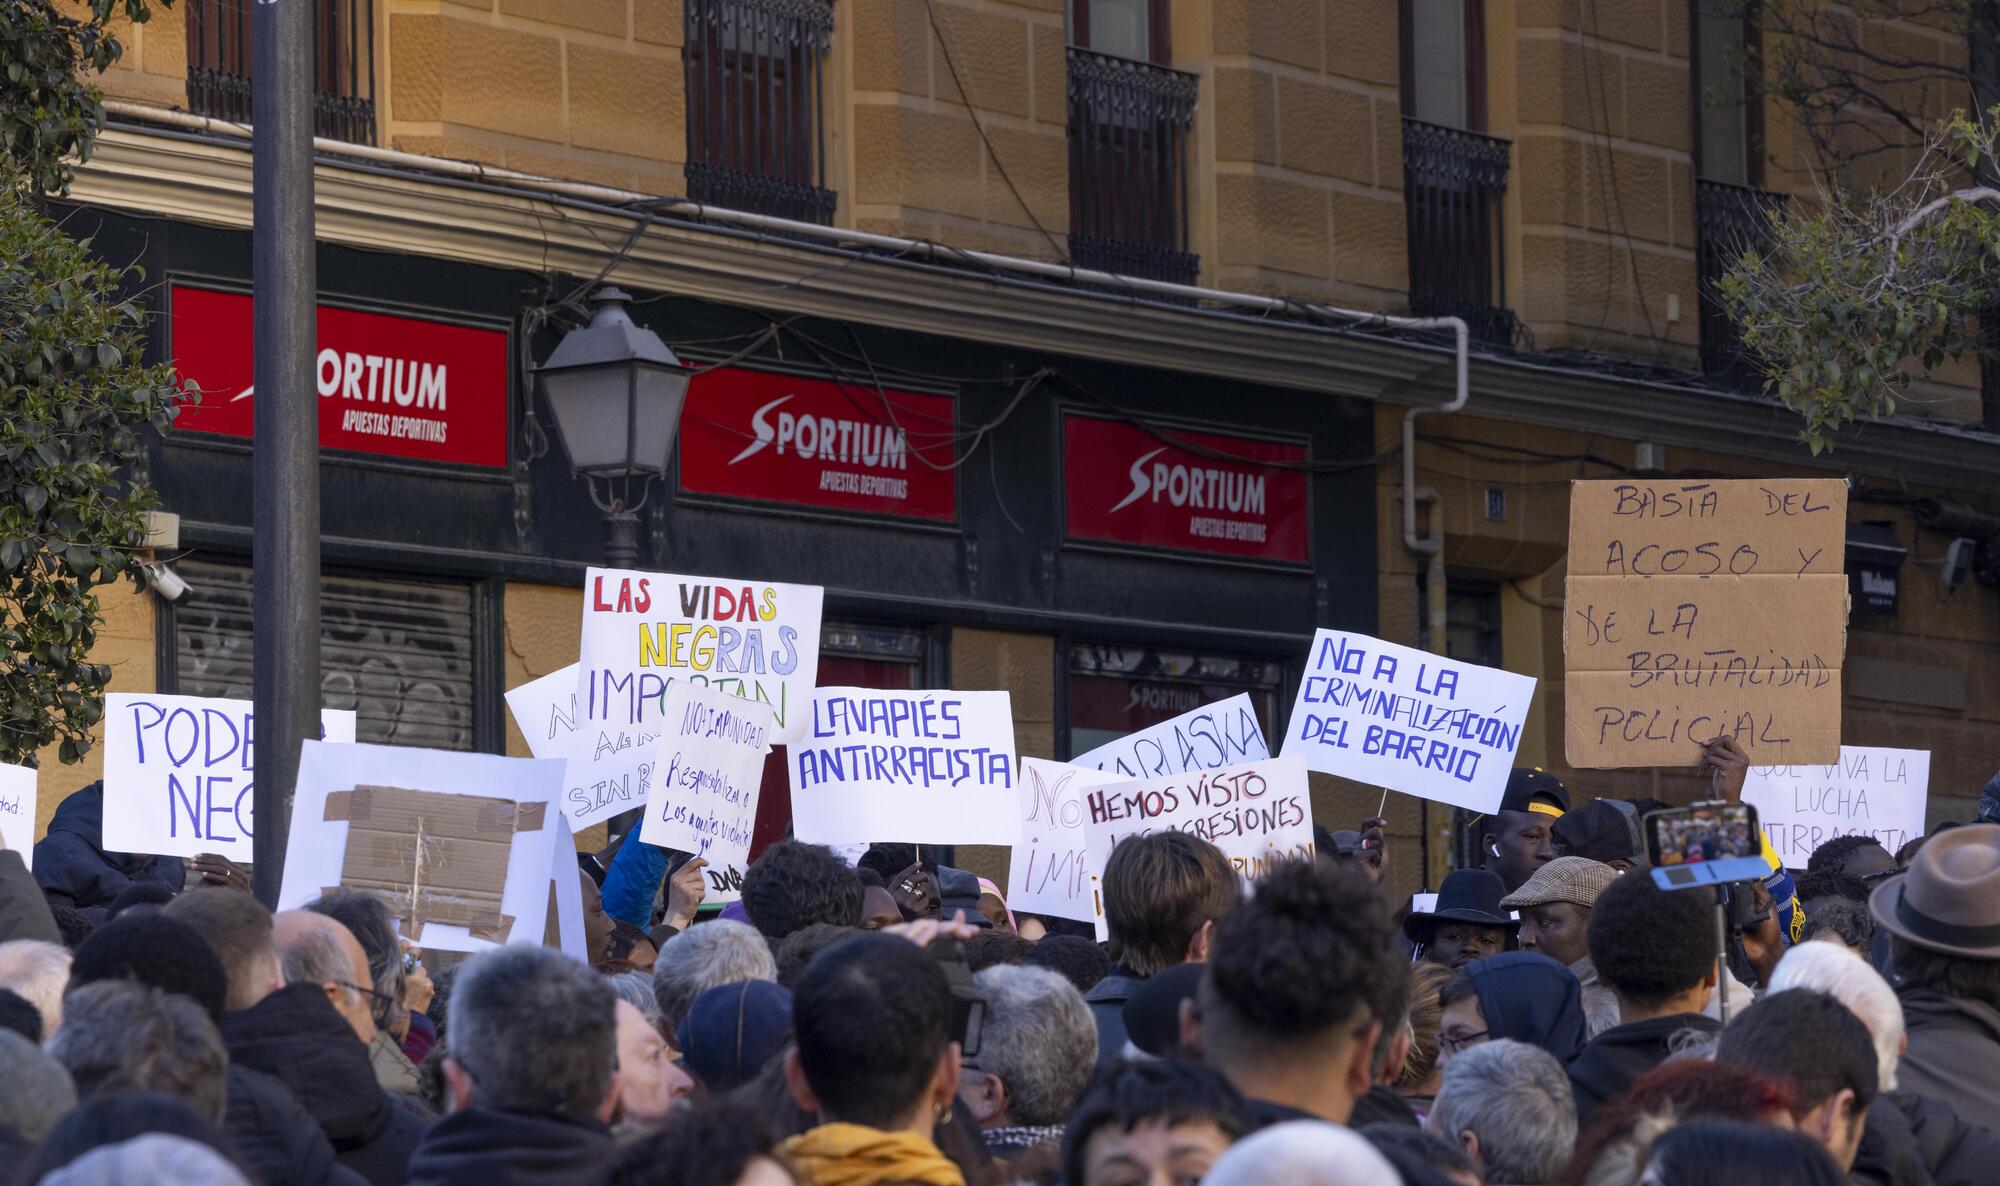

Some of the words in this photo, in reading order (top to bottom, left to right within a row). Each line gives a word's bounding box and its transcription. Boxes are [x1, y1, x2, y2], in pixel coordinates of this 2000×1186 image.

[230, 348, 447, 411] ORTIUM
[342, 409, 389, 437] APUESTAS
[391, 416, 447, 444] DEPORTIVAS
[727, 394, 907, 470] SPORTIUM
[819, 469, 859, 494] APUESTAS
[860, 474, 908, 500] DEPORTIVAS
[1109, 446, 1266, 515] SPORTIUM
[1613, 484, 1717, 518] BASTA
[1759, 487, 1830, 516] DEL
[1606, 539, 1759, 579] ACOSO
[1798, 547, 1823, 580] Y
[593, 576, 651, 614] LAS
[679, 583, 777, 622] VIDAS
[1648, 602, 1698, 640] LA
[639, 622, 798, 675] NEGRAS
[1373, 654, 1398, 684] A
[1415, 663, 1459, 700] LA
[814, 693, 962, 740] LAVAPIÉS
[1303, 676, 1520, 753] CRIMINALIZACIÓN
[1301, 714, 1349, 749] DEL
[1363, 724, 1482, 783] BARRIO
[1884, 757, 1907, 785] LA
[169, 772, 254, 843] NEG
[568, 773, 631, 818] SIN
[662, 800, 687, 824] Los
[1087, 786, 1179, 825] HEMOS
[1795, 786, 1870, 820] LUCHA
